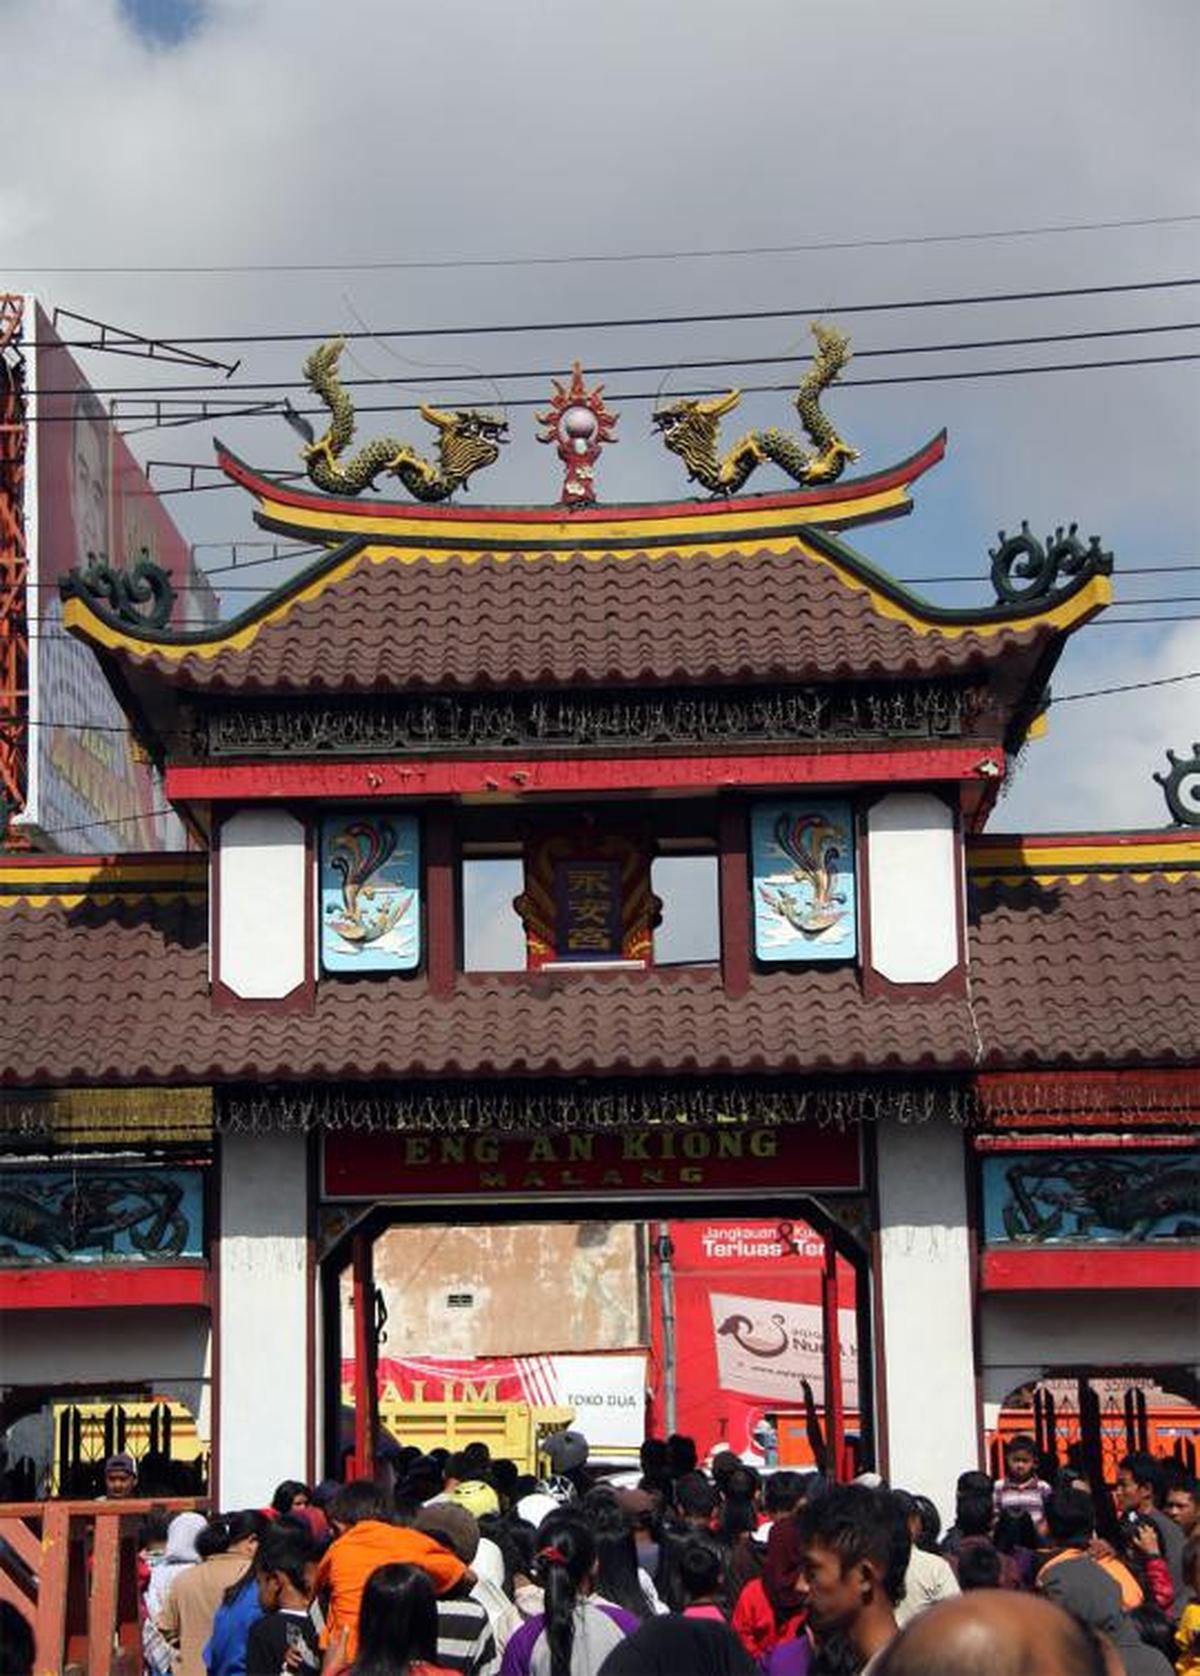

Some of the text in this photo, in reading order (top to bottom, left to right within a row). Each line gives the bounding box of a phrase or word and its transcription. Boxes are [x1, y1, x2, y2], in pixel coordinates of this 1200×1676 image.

[404, 1129, 778, 1165] ENG AN KIONG
[479, 1165, 706, 1188] MALANG
[703, 1226, 777, 1242] Jangkauan
[703, 1238, 825, 1257] Terluas Ter
[567, 1393, 603, 1407] TOKO
